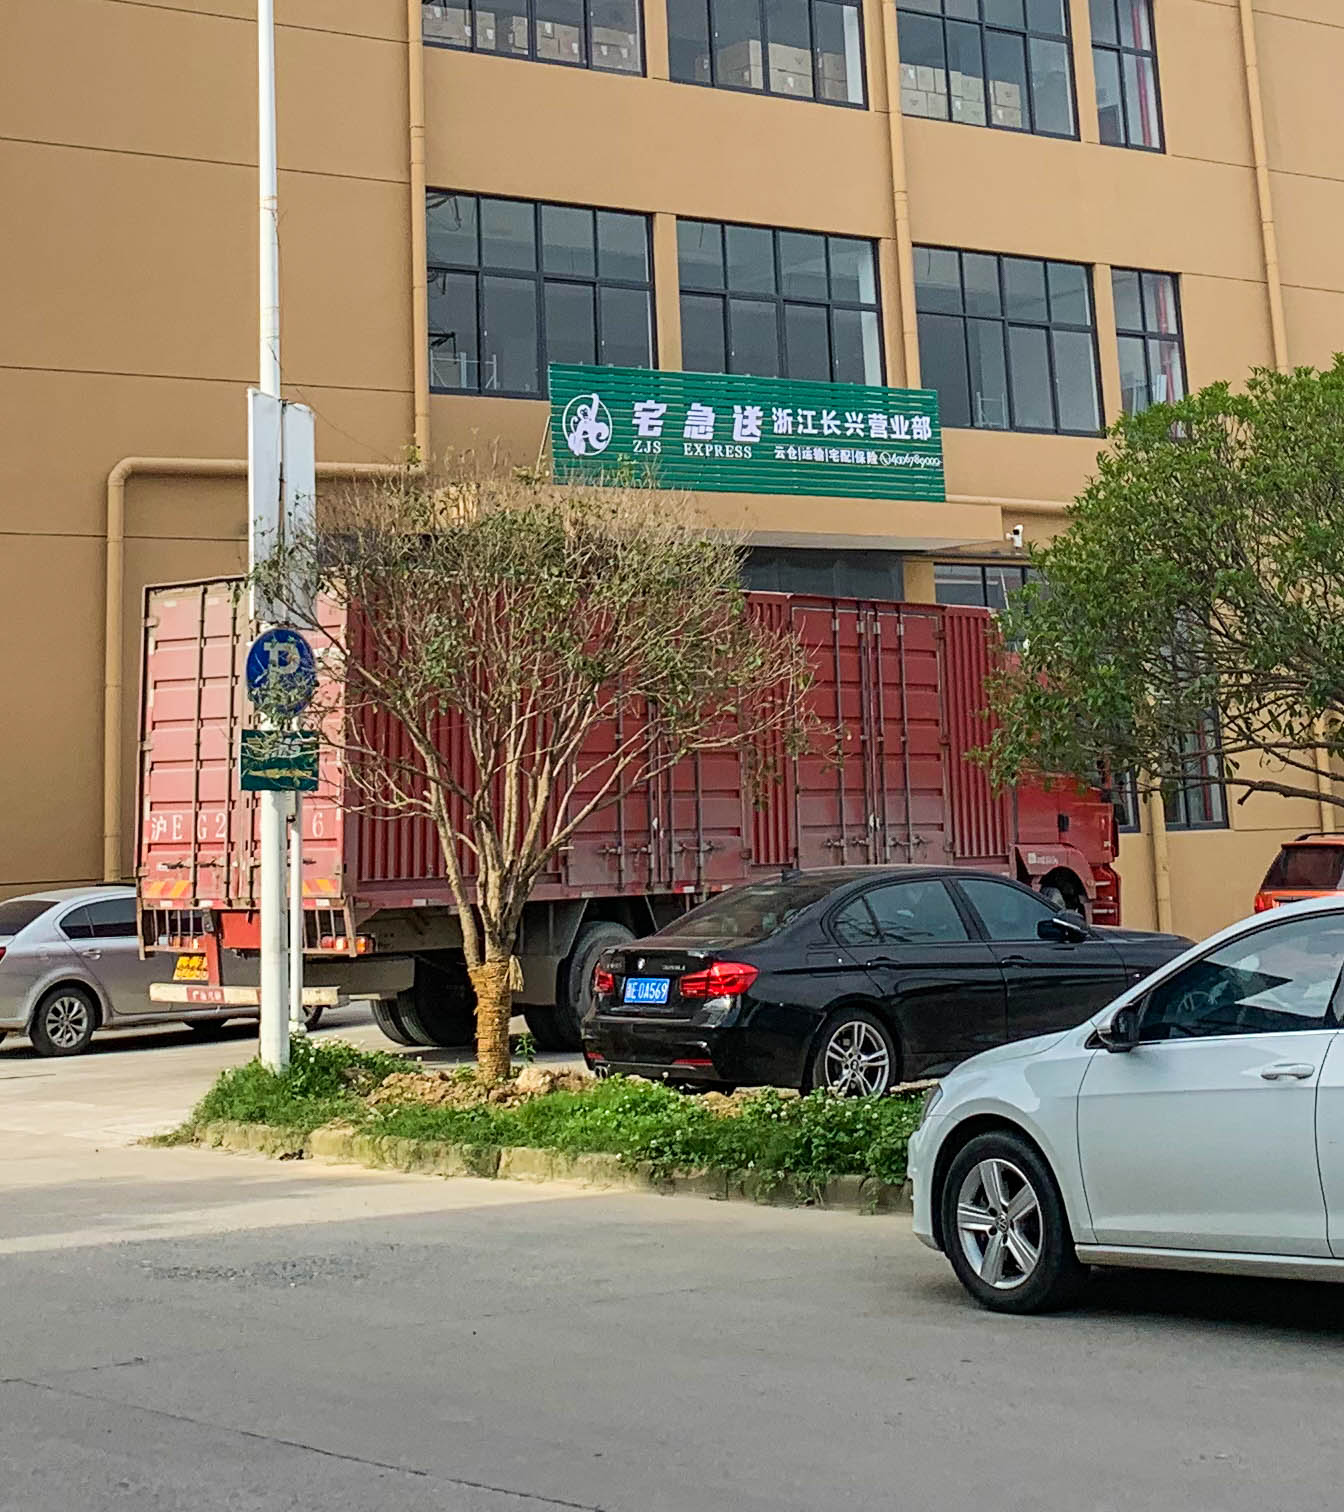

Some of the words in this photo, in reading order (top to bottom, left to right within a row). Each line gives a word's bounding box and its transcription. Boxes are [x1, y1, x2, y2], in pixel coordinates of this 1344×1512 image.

[631, 399, 763, 443] 宅急送
[771, 406, 932, 442] 浙江长兴营业部
[632, 439, 662, 455] ZJS
[683, 442, 753, 460] EXPRESS
[263, 641, 301, 691] P
